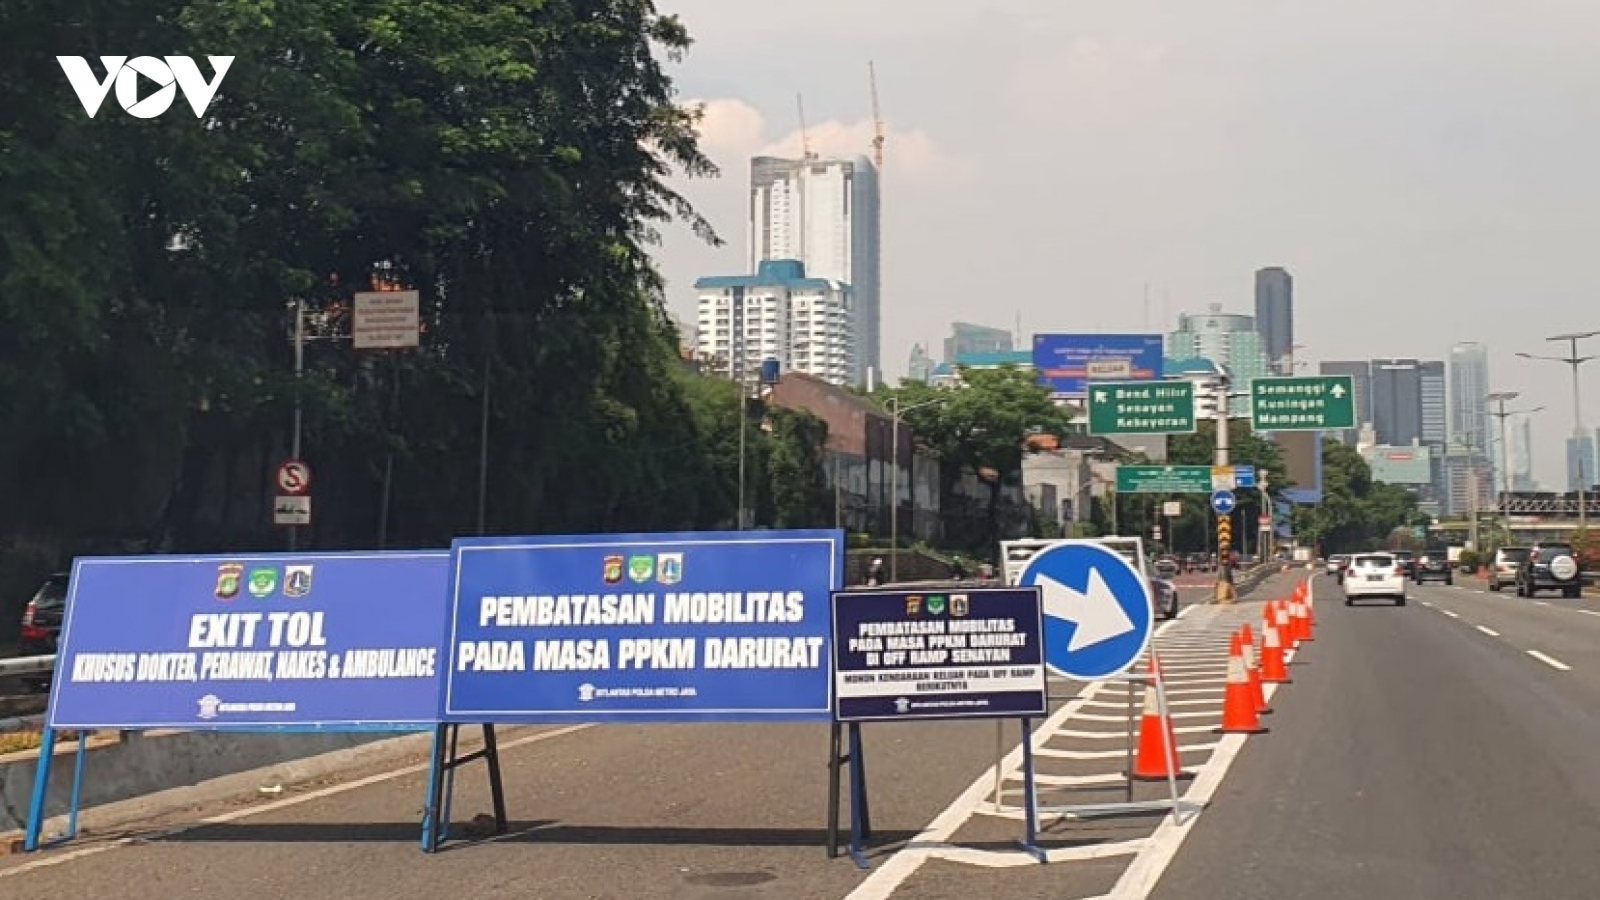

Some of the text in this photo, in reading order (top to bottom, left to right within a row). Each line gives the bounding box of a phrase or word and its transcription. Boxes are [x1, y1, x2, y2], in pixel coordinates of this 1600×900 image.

[1257, 384, 1326, 396] Semanggi
[1117, 404, 1174, 414] Senayan
[1258, 400, 1324, 411] Kuningan
[1117, 418, 1187, 429] Kebayoran
[1258, 413, 1324, 425] Mampang
[480, 591, 804, 626] PEMBATASAN MOBILITAS
[189, 611, 326, 648] EXIT TOL
[859, 619, 1015, 636] PEMBATASAN MOBILITAS
[849, 633, 1027, 652] PADA MASA PPKM DARURAT
[457, 637, 823, 671] PADA MASA PPKM DARURAT
[883, 650, 907, 665] OFF
[910, 649, 949, 665] RAMP
[952, 648, 1011, 664] SENAYAN
[71, 648, 437, 683] KHUSUS DOKTER, PERAWAT, NAKES & AMBULANCE
